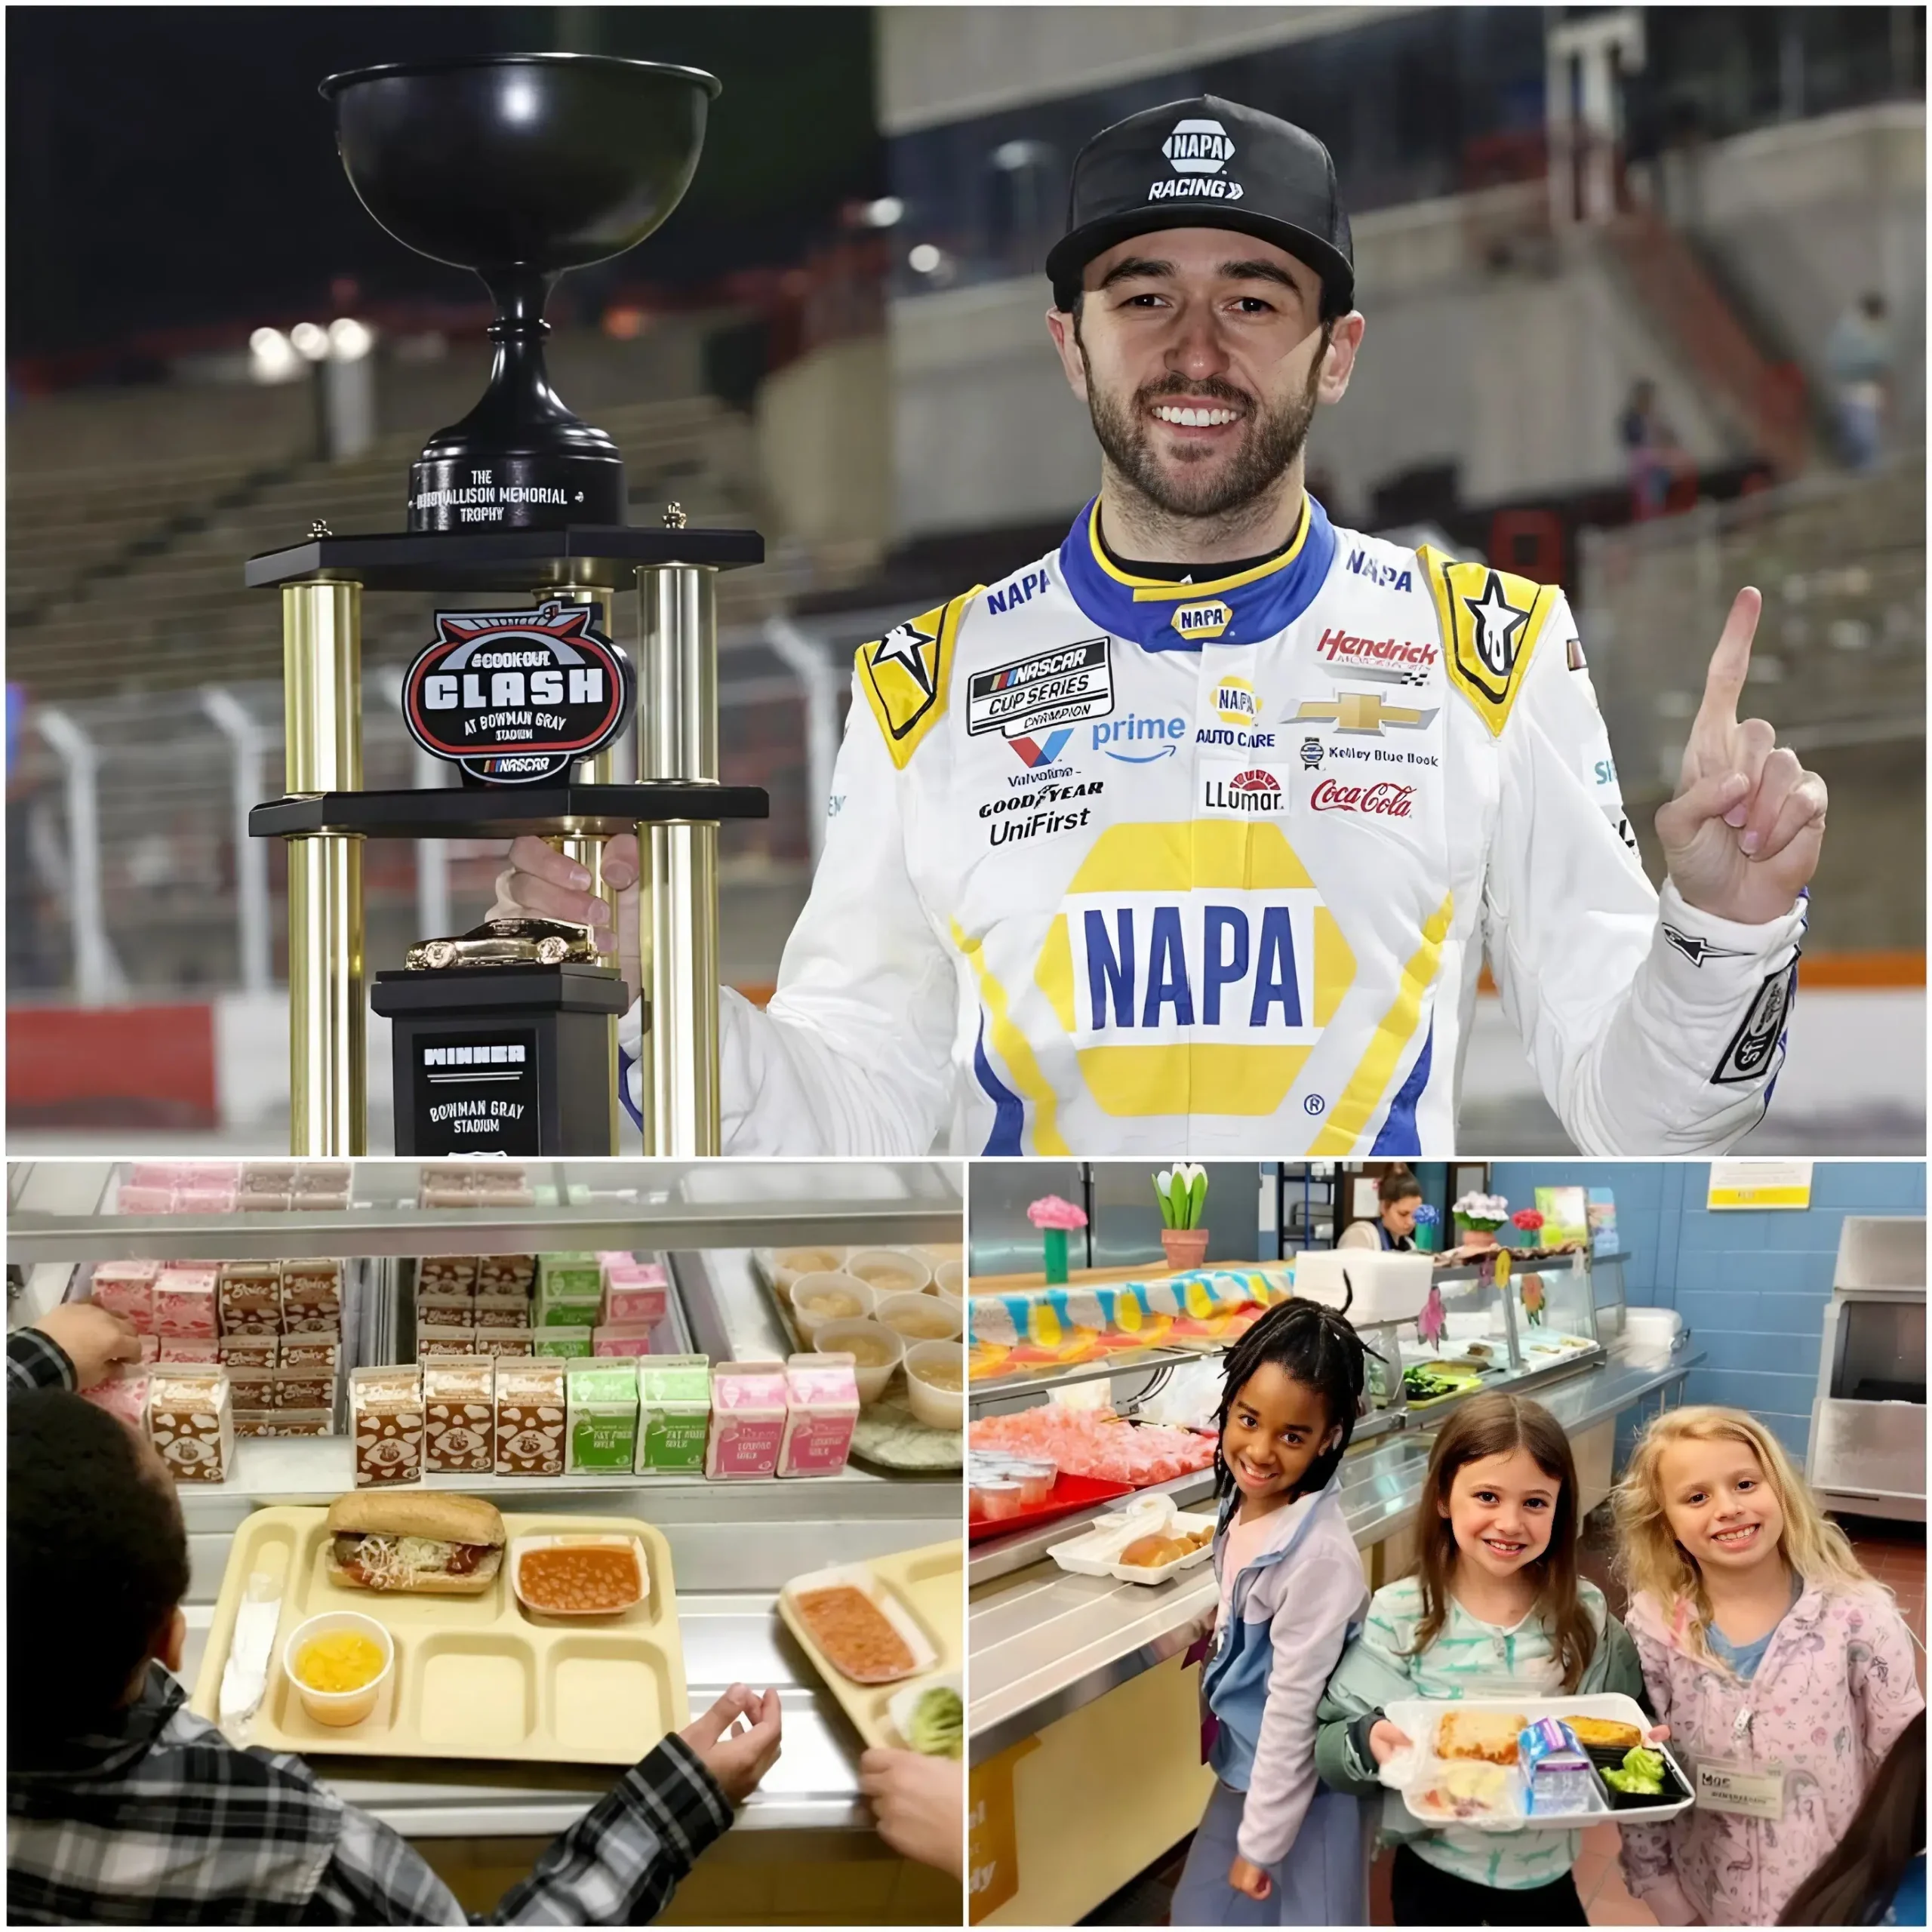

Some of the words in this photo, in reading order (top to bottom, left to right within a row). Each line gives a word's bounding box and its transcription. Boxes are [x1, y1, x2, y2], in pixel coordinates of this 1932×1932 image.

[1174, 134, 1223, 159] NAPA
[1148, 178, 1226, 201] RACING
[471, 470, 492, 485] THE
[500, 488, 568, 505] MEMORIAL
[460, 506, 505, 522] TROPHY
[1346, 549, 1412, 593] NAPA
[987, 568, 1051, 615] NAPA
[1181, 608, 1224, 628] NAPA
[1316, 628, 1439, 666] Hendrick
[1016, 648, 1088, 685] NASCAR
[424, 668, 603, 709] CLASH
[989, 690, 1025, 715] CUP
[1026, 673, 1090, 705] SERIES
[1219, 689, 1254, 715] NAPA
[465, 719, 477, 736] AT
[479, 710, 533, 731] BOWMAN
[535, 712, 567, 731] GRAY
[1092, 712, 1186, 751] prime
[1195, 728, 1235, 746] AUTO
[1237, 731, 1275, 749] CARE
[499, 756, 550, 773] NASCAR
[1329, 746, 1371, 761] Kelley
[1375, 749, 1404, 763] Blue
[1594, 759, 1617, 785] SI
[979, 781, 1104, 819] GOODYEAR
[1205, 781, 1282, 812] LLumar
[1310, 778, 1417, 817] Coca-Cola
[990, 808, 1091, 846] UniFirst
[1084, 905, 1303, 1031] NAPA
[424, 1044, 525, 1066] WINNER
[429, 1100, 486, 1123] BOWMAN
[491, 1100, 525, 1120] GRAY
[454, 1119, 500, 1134] STADIUM
